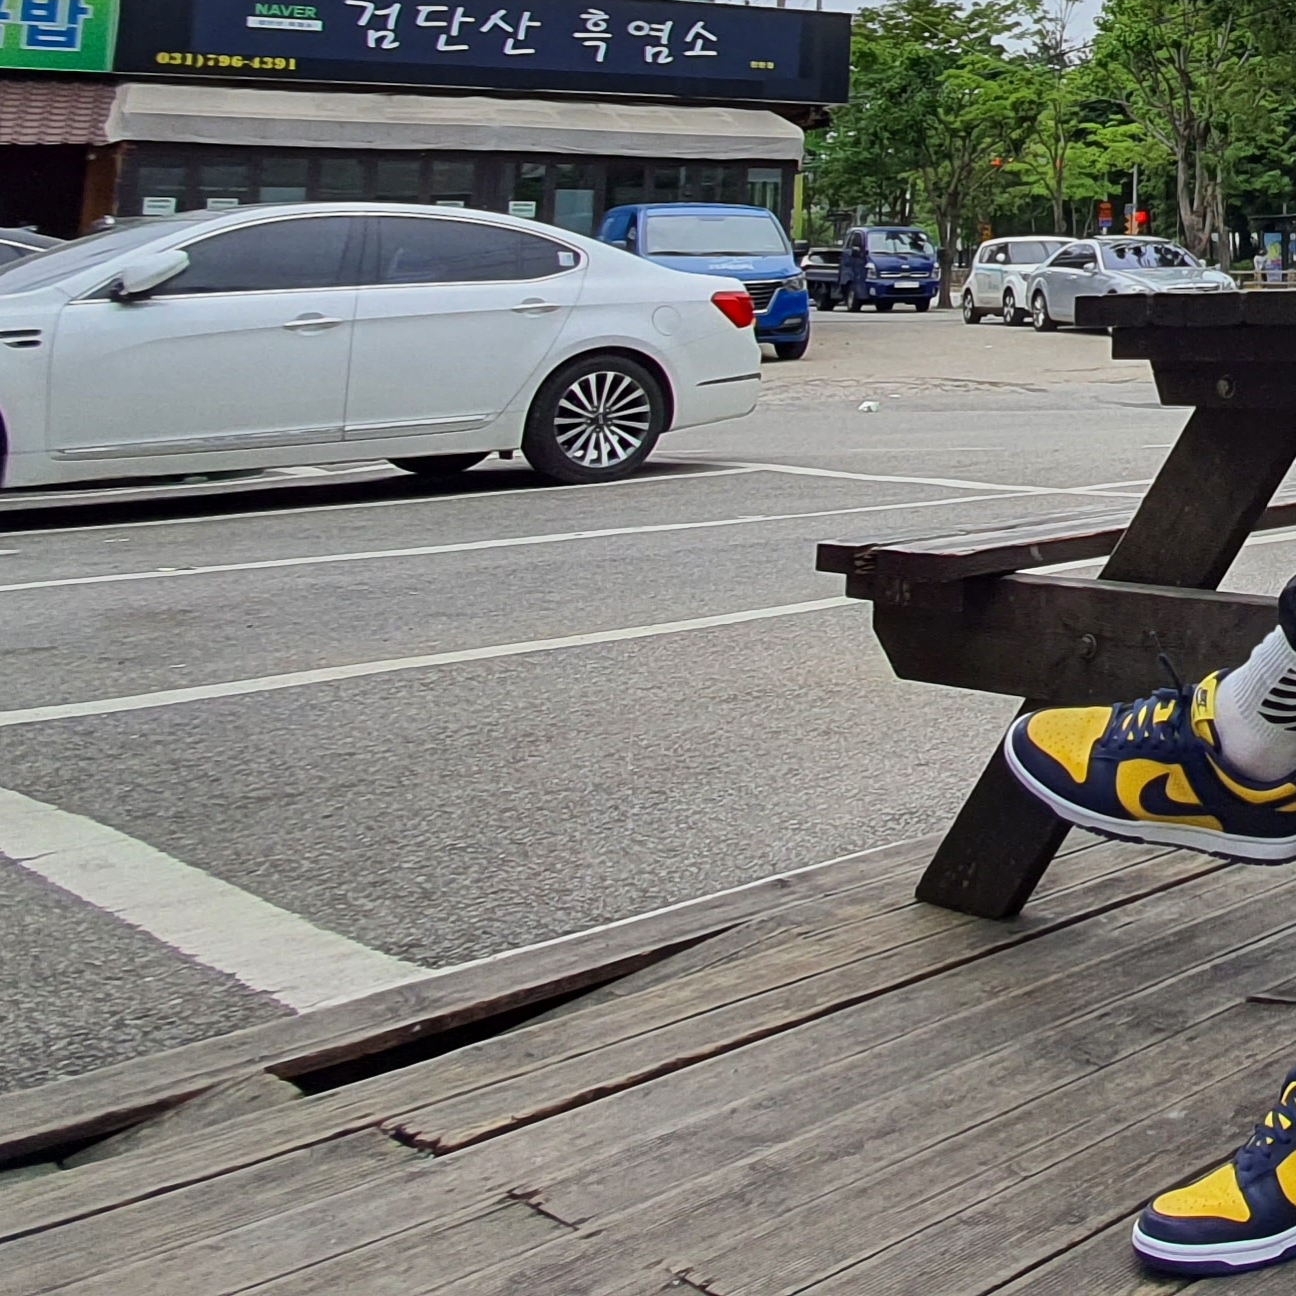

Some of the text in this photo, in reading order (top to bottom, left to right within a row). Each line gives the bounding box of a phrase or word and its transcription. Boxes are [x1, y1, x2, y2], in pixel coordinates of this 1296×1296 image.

[254, 3, 318, 19] NAVER
[344, 0, 718, 64] 검단산 흑염소
[155, 51, 298, 71] 031)796-4391
